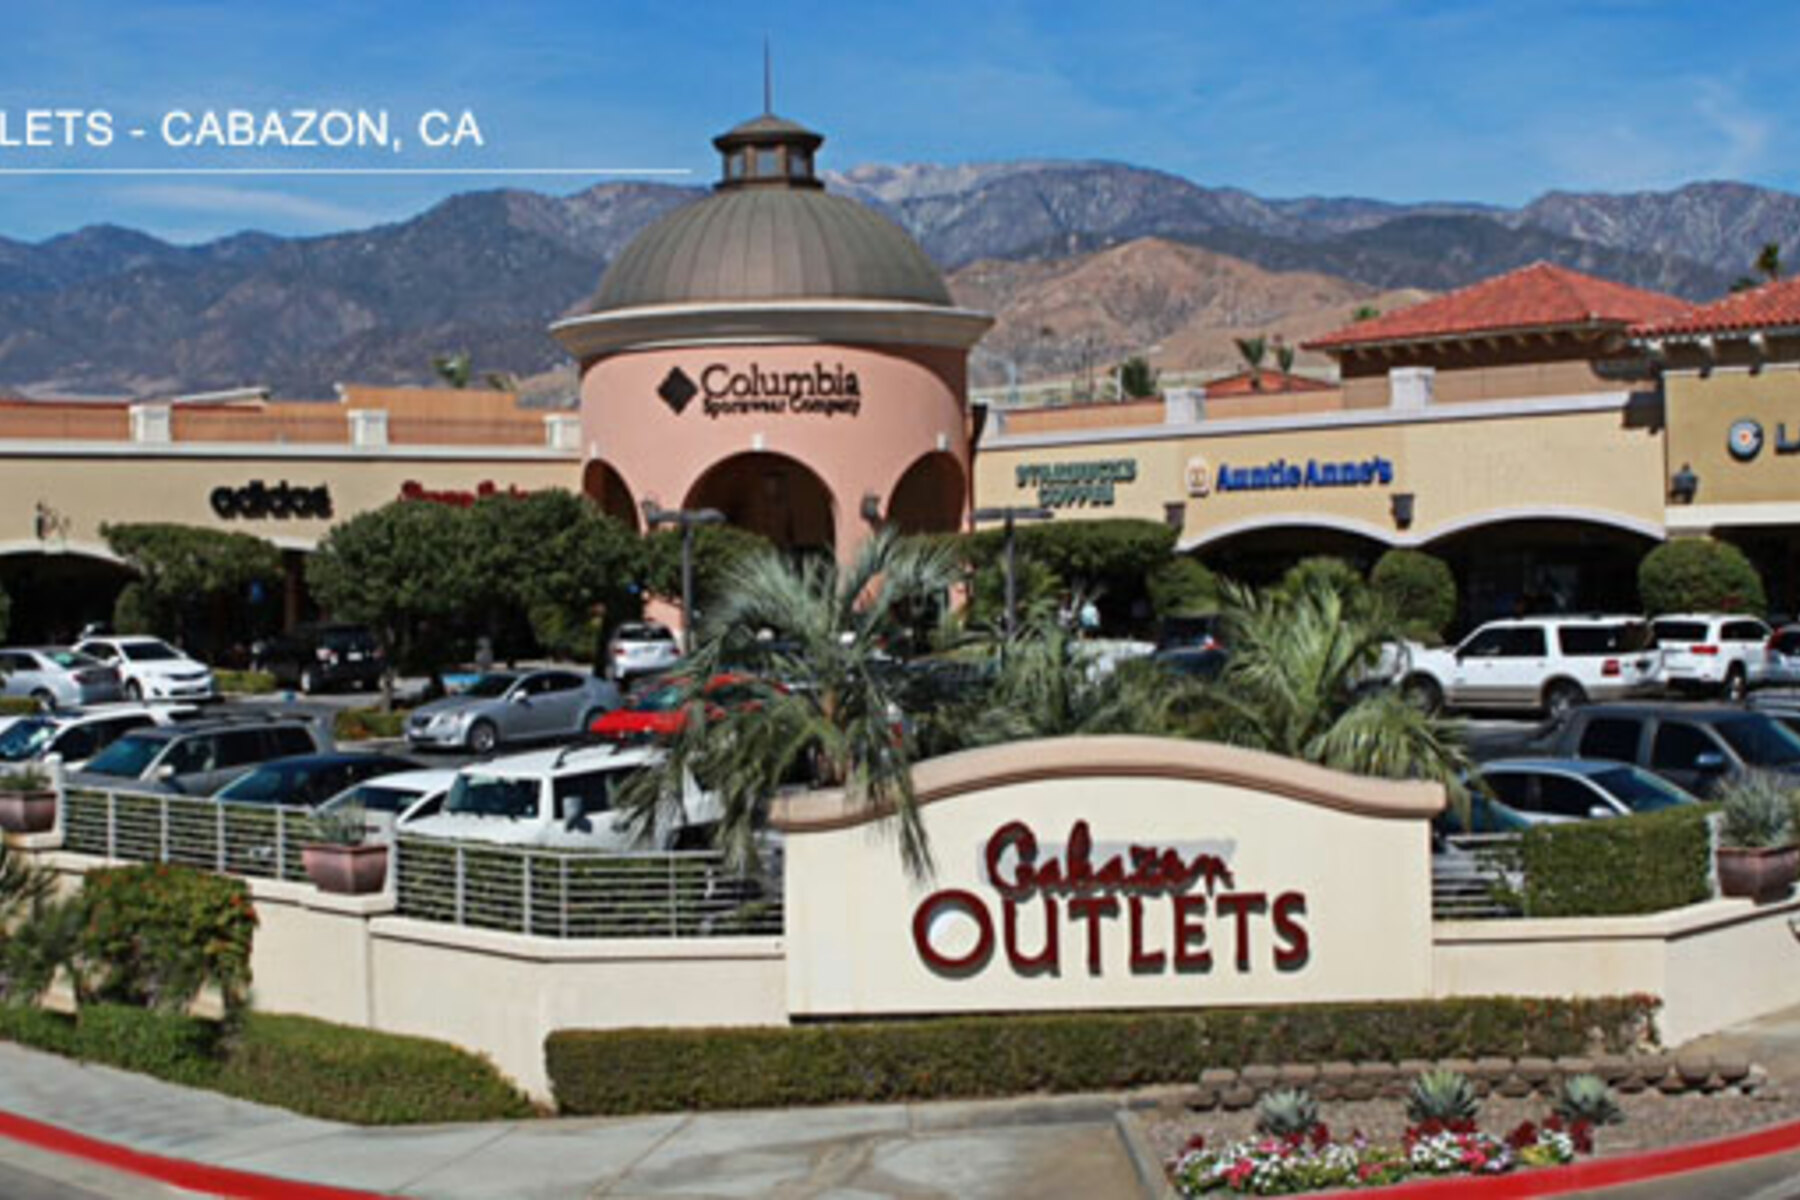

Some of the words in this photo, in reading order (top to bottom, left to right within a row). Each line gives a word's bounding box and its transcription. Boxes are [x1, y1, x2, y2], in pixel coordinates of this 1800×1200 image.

[701, 362, 860, 399] Columbia
[790, 398, 860, 417] Company
[1016, 459, 1136, 488] STARBUCKS
[1216, 458, 1301, 492] Auntie
[1304, 455, 1392, 488] Anne's
[210, 479, 333, 519] adidas
[1039, 482, 1114, 508] COFFEE
[985, 819, 1235, 903] Cabazon
[912, 888, 1310, 981] OUTLETS
